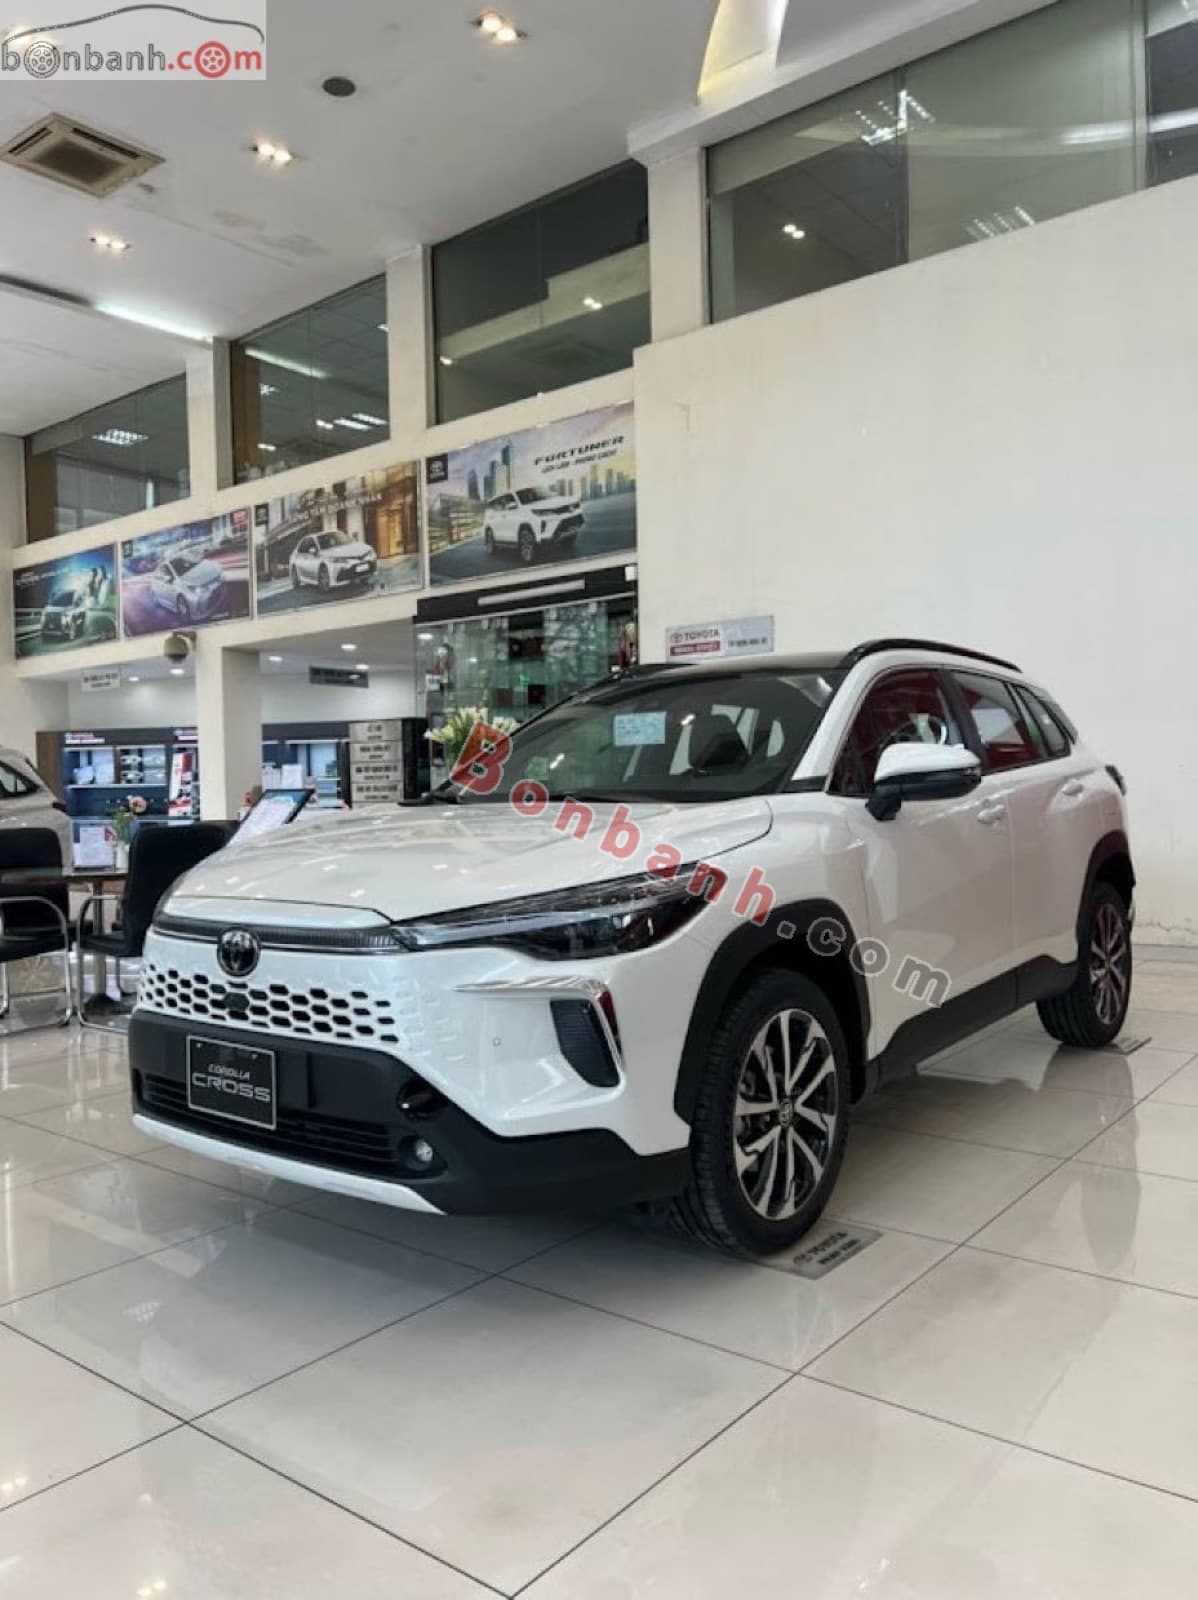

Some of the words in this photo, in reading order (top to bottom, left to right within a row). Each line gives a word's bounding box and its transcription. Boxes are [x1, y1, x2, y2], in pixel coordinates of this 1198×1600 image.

[684, 628, 719, 641] TOYOTA
[208, 1063, 250, 1081] COROLLA
[192, 1072, 271, 1102] CROSS
